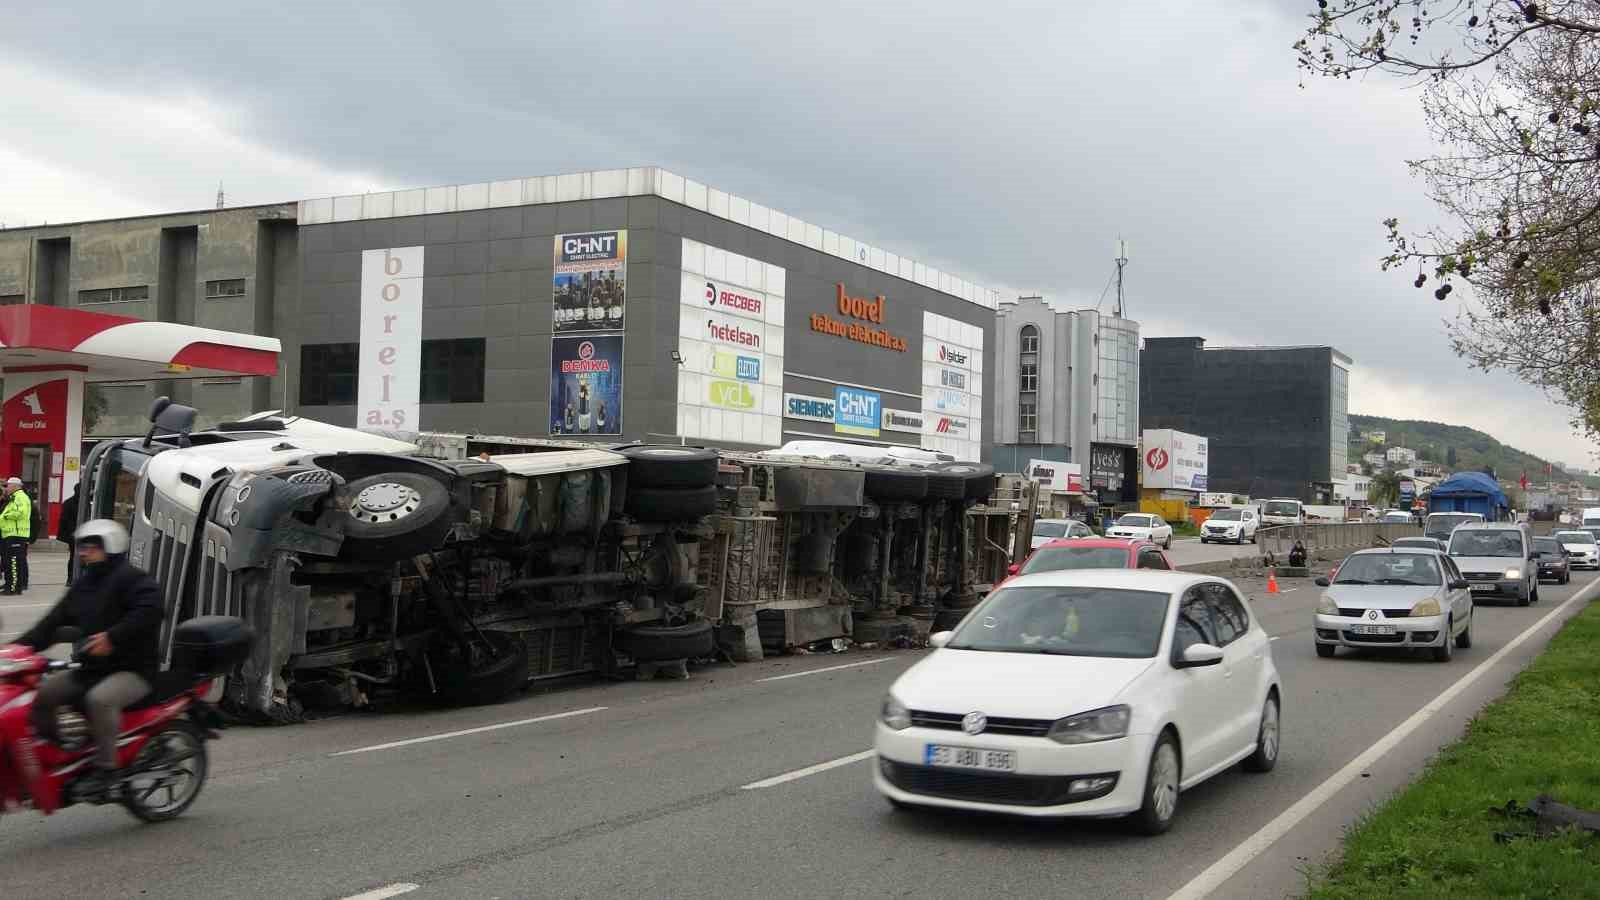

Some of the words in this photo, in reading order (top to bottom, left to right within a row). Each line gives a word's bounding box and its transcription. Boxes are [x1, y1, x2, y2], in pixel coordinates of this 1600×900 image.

[836, 281, 886, 324] borel
[809, 312, 847, 337] tekno
[561, 360, 609, 372] DEMKA
[788, 398, 834, 418] SIEMENS
